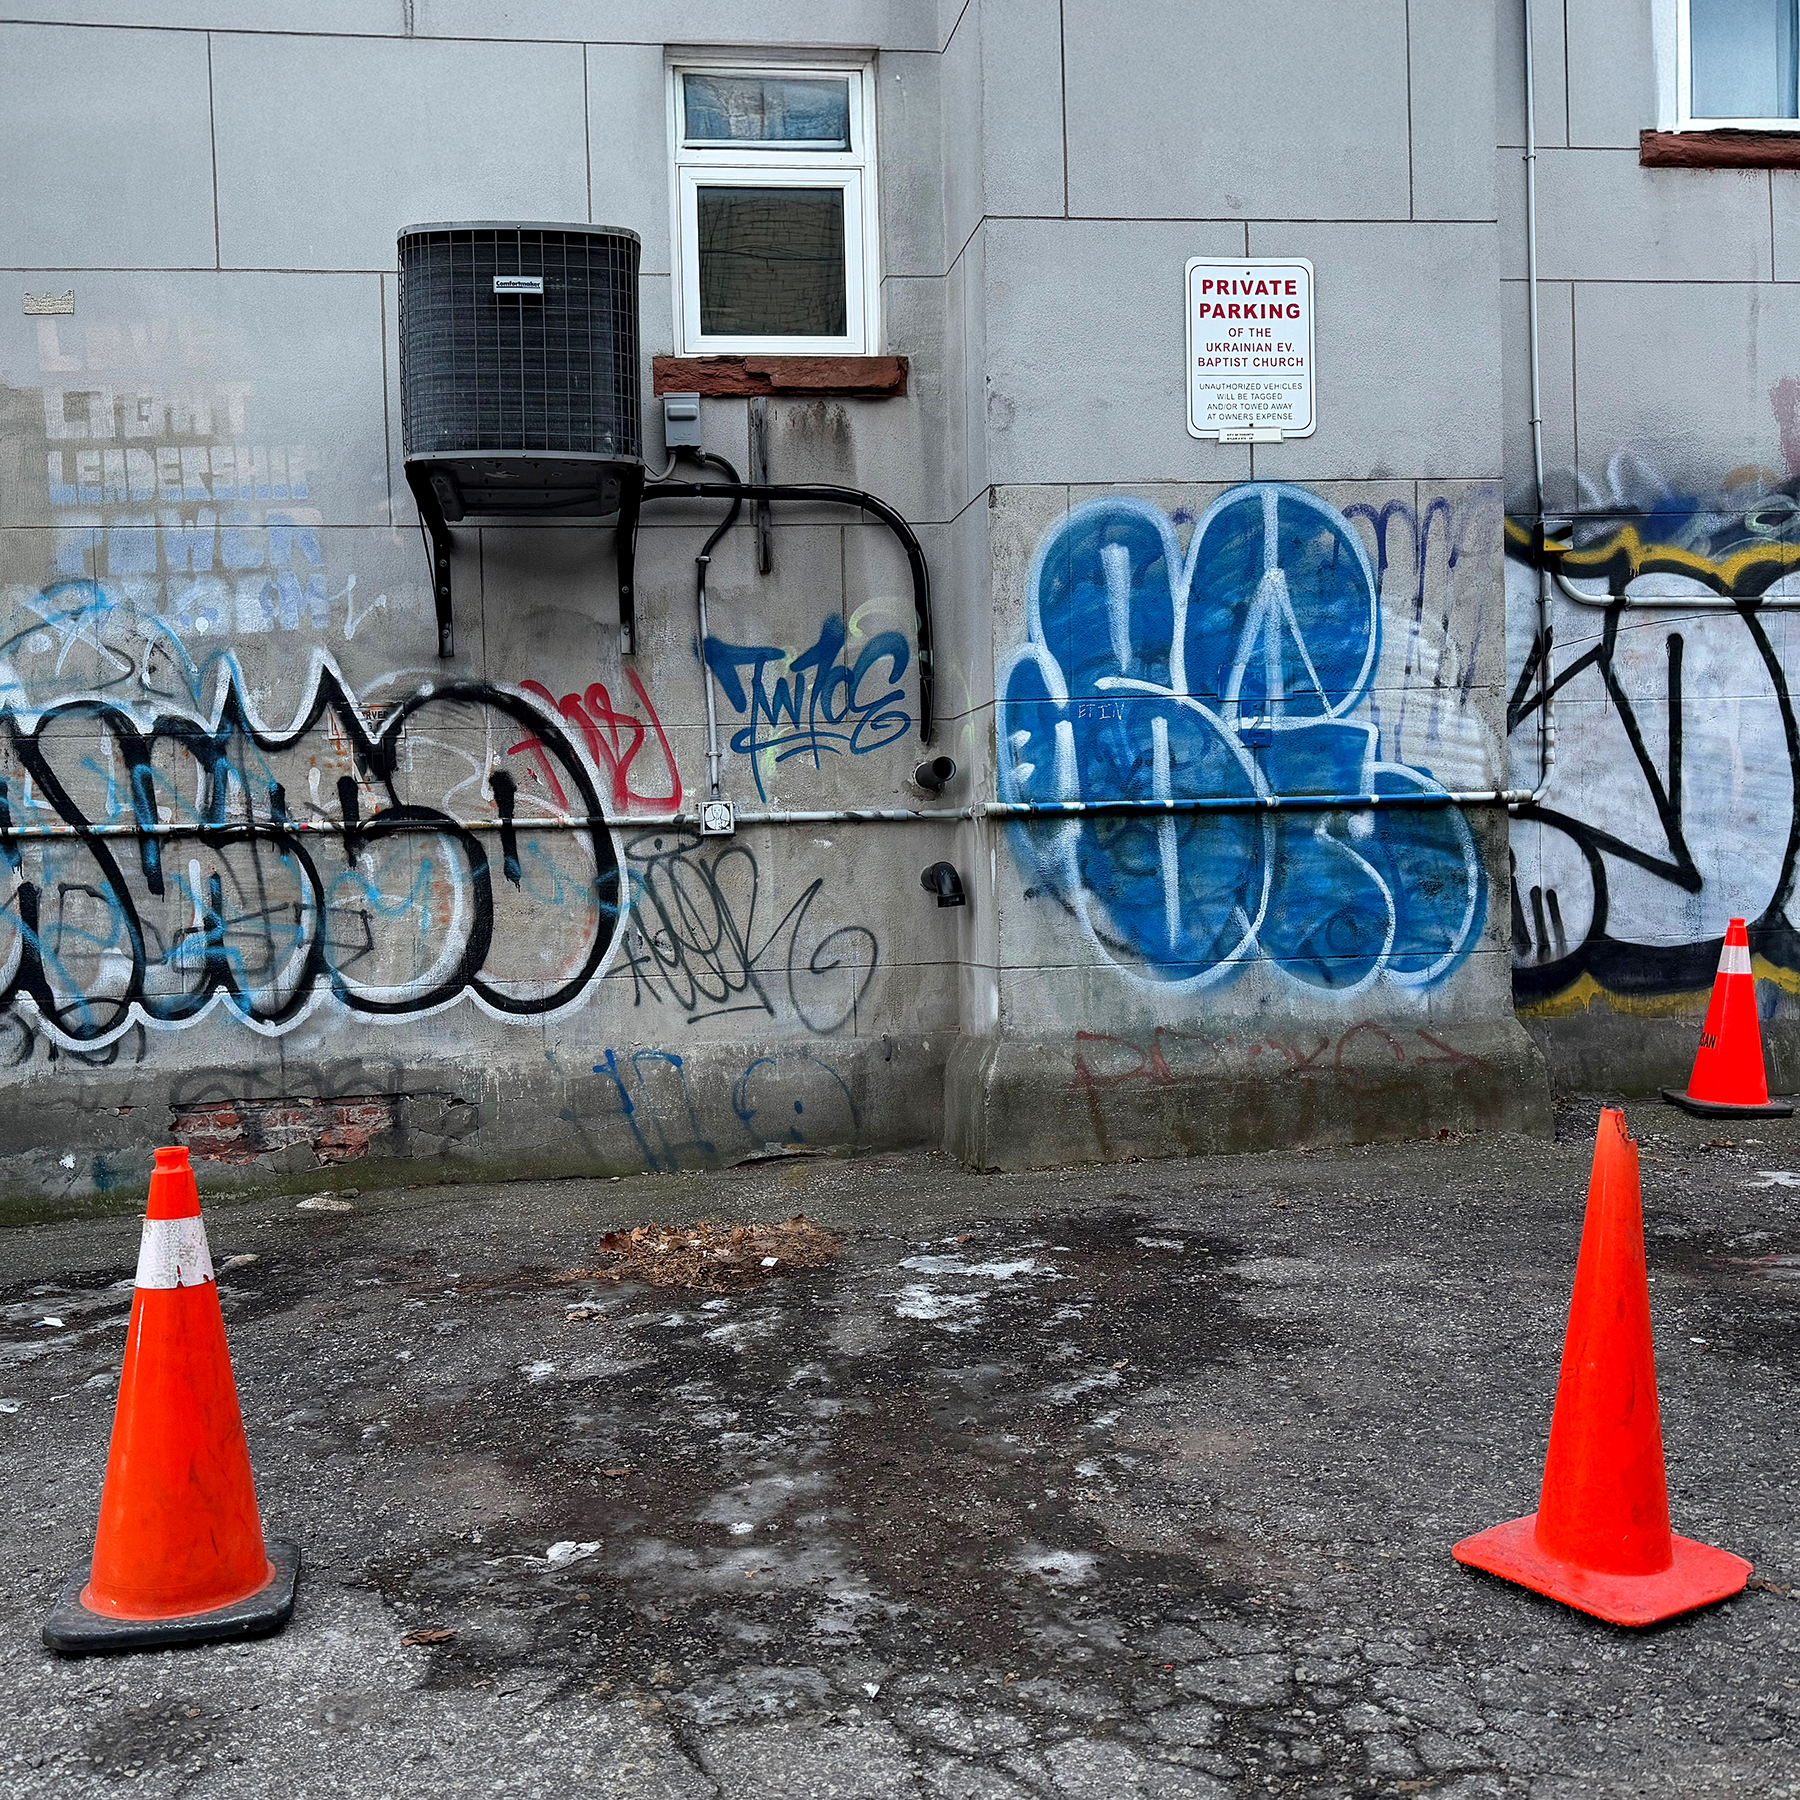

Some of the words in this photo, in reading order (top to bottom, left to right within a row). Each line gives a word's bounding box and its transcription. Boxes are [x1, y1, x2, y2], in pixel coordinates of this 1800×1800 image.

[1202, 279, 1297, 295] PRIVATE
[1199, 303, 1300, 319] PARKING
[1228, 327, 1244, 337] OF
[1249, 327, 1272, 337] THE
[1206, 342, 1272, 352] UKRAINIAN
[1277, 342, 1295, 352] EV.
[1197, 357, 1248, 367] BAPTIST
[1252, 357, 1304, 367] CHURCH
[1199, 382, 1261, 390] UNAUTHORIZED
[1263, 382, 1303, 390] VEHICLES
[1216, 392, 1235, 400] WILL
[1237, 392, 1248, 400] BE
[1251, 392, 1283, 400] TAGGED
[1206, 403, 1238, 411] AND/OR
[1240, 403, 1269, 411] TOWED
[1270, 403, 1293, 411] AWAY
[1206, 413, 1217, 421] AT
[1218, 413, 1254, 421] OWNERS
[1247, 708, 1266, 739] 2
